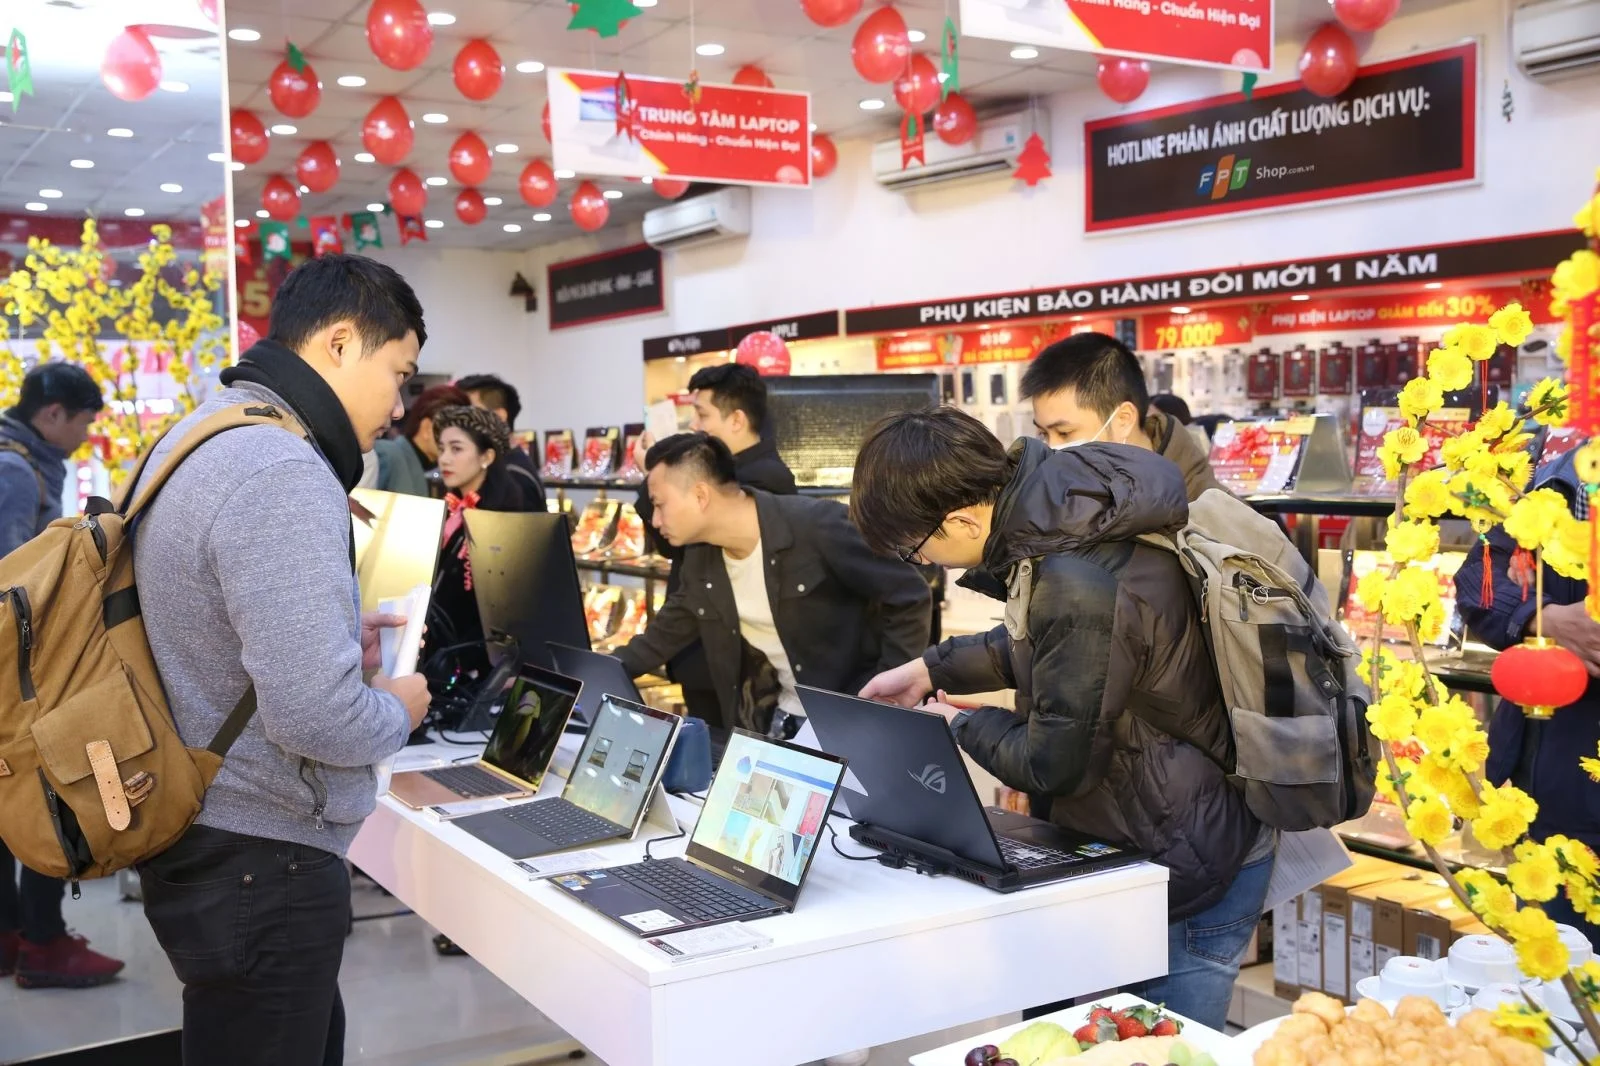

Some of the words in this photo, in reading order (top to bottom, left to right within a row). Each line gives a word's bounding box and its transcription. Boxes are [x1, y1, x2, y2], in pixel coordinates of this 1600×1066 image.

[638, 106, 697, 126] TRUNG
[740, 115, 800, 134] LAPTOP
[1107, 135, 1166, 167] HOTLINE
[1211, 120, 1246, 148] ÁNH
[1291, 100, 1350, 135] LƯỢNG
[1353, 92, 1395, 126] DỊCH
[1398, 85, 1431, 117] VỤ:
[920, 303, 967, 323] PHỤ
[973, 296, 1030, 319] KIỆN
[1100, 280, 1181, 306] HÀNH
[1252, 264, 1316, 290] MỚI
[1327, 262, 1342, 282] 1
[1355, 252, 1438, 280] NĂM
[1328, 308, 1376, 322] LAPTOP
[1446, 294, 1497, 318] 30%
